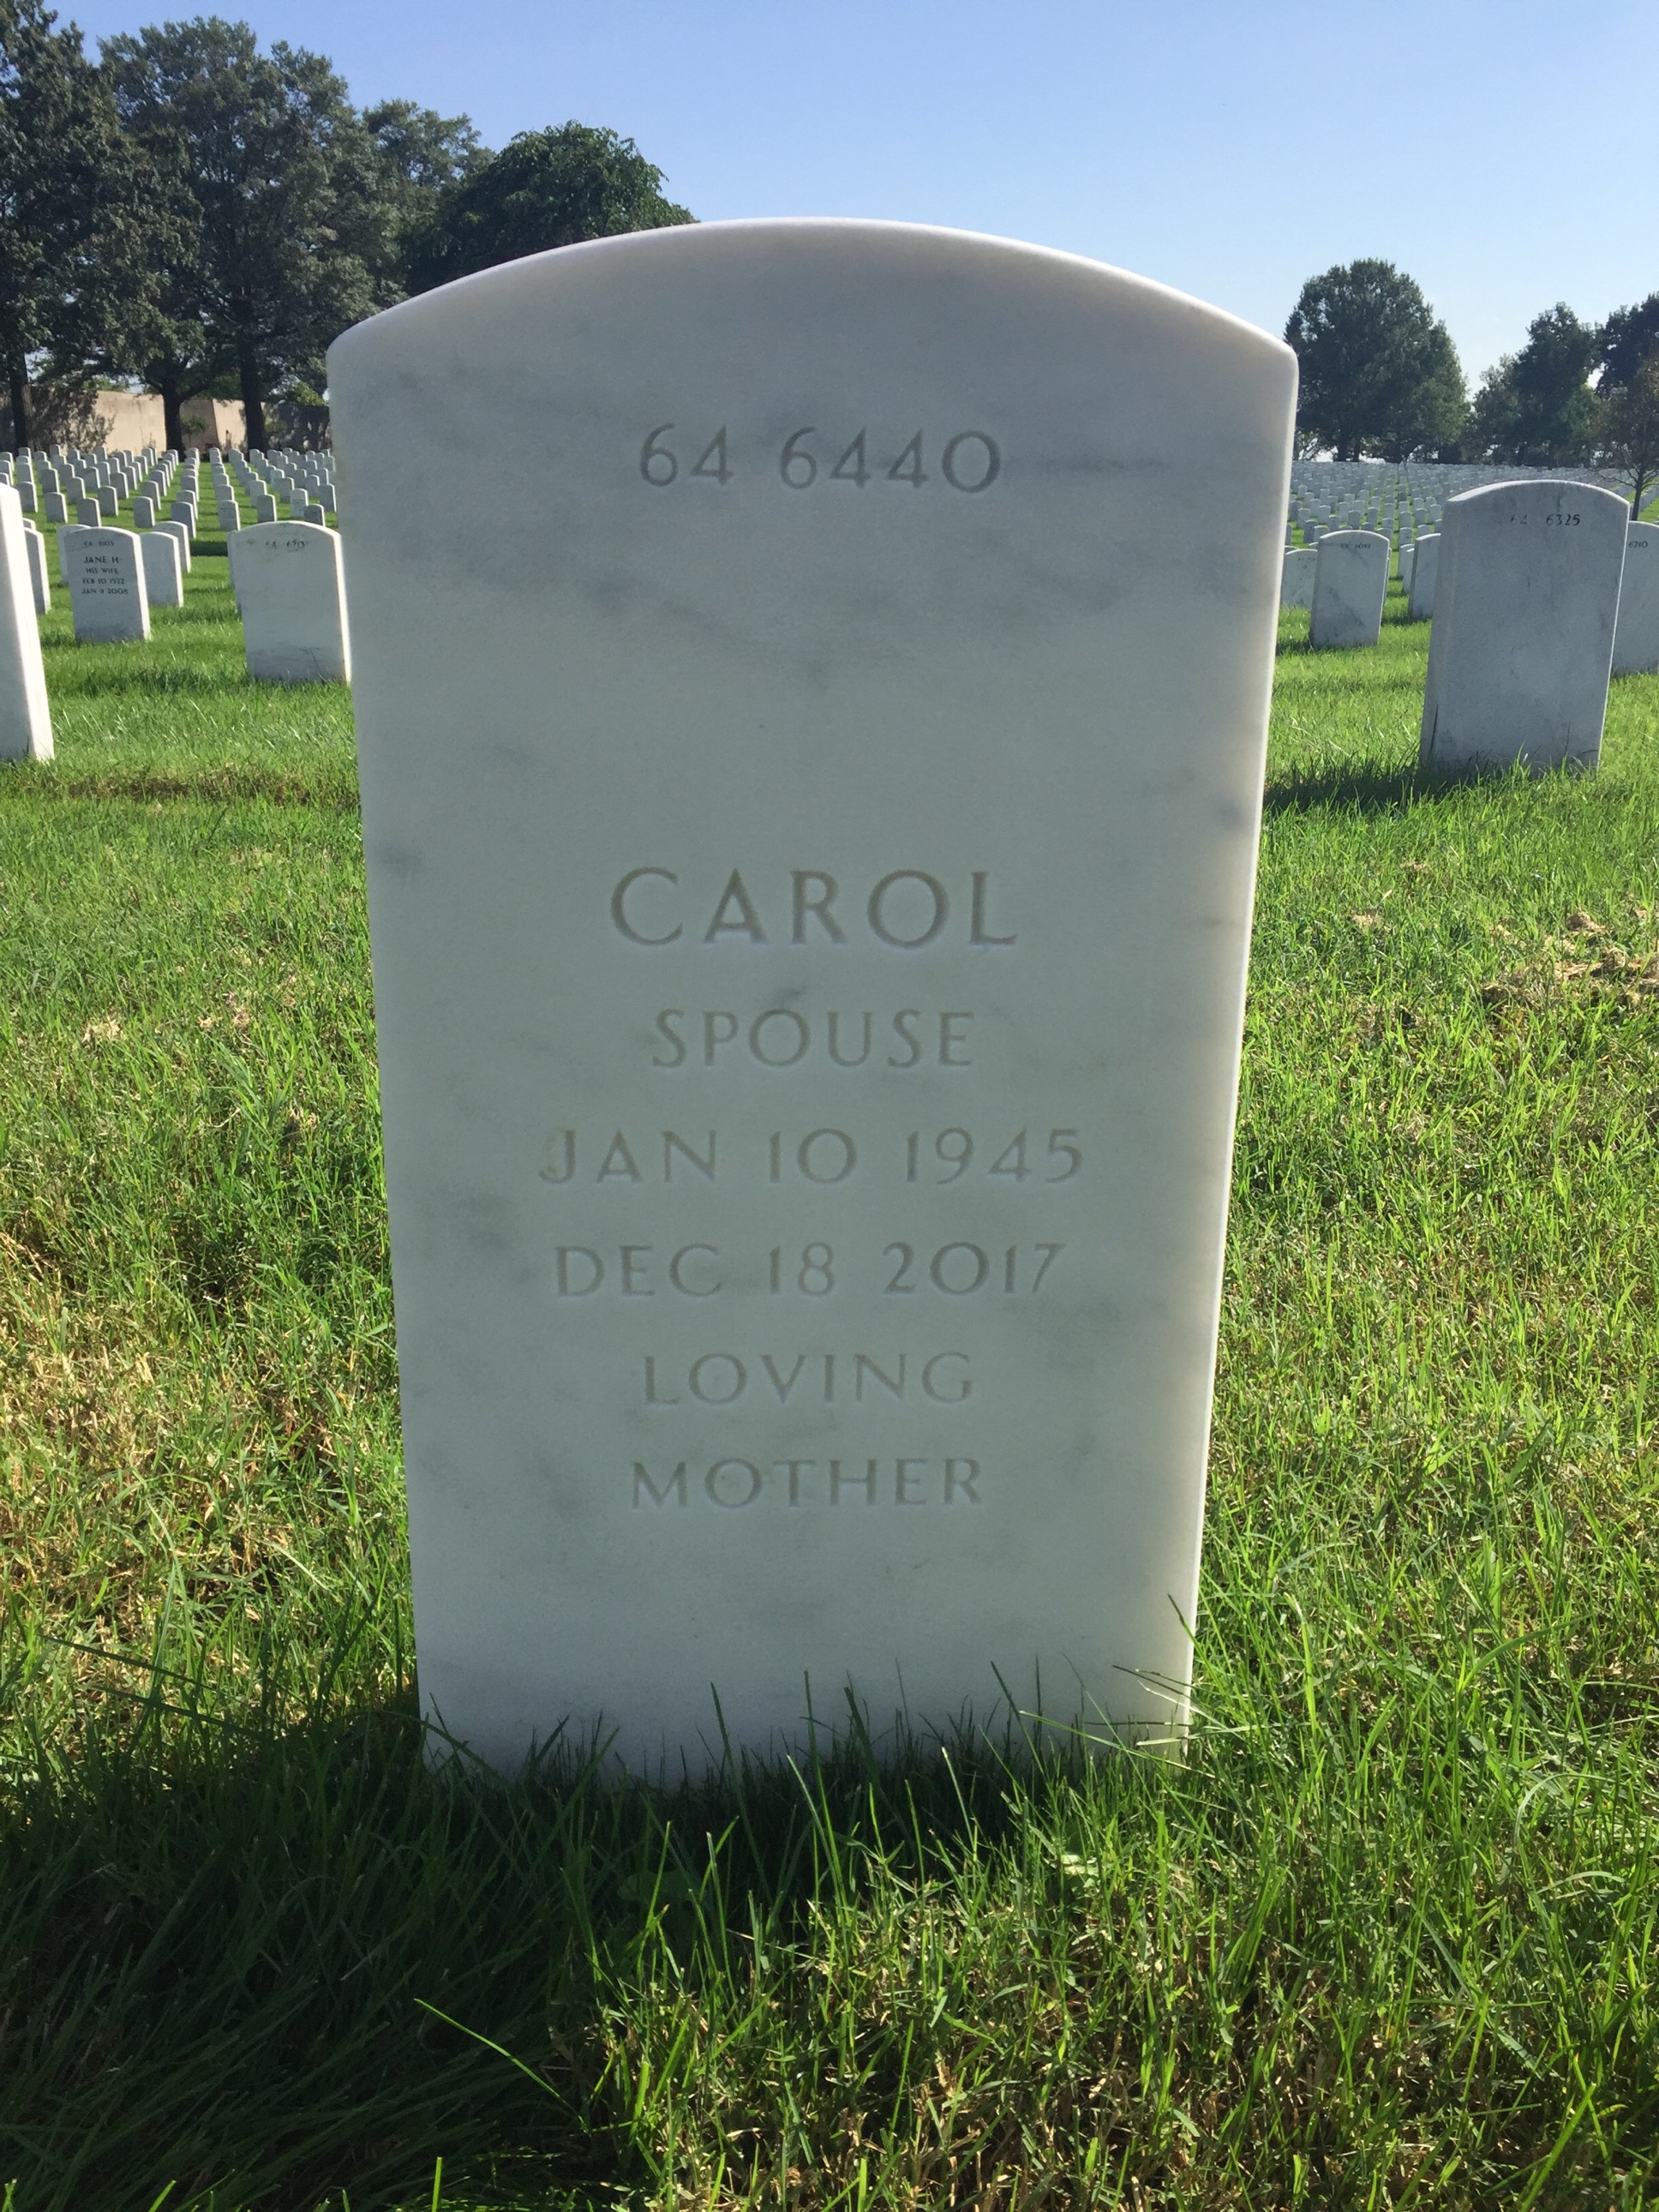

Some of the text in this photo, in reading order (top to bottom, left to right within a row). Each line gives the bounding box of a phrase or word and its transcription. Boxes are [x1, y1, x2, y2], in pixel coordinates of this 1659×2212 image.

[640, 423, 1001, 494] 64 6440
[1546, 514, 1580, 526] 6325
[83, 555, 119, 564] JANE H
[610, 866, 1019, 948] CAROL
[651, 1008, 975, 1068] SPOUSE
[538, 1127, 1084, 1185] JAN 10 1945
[554, 1241, 1068, 1298] DEC 18 2017
[643, 1351, 973, 1406] LOVING
[630, 1458, 983, 1508] MOTHER
